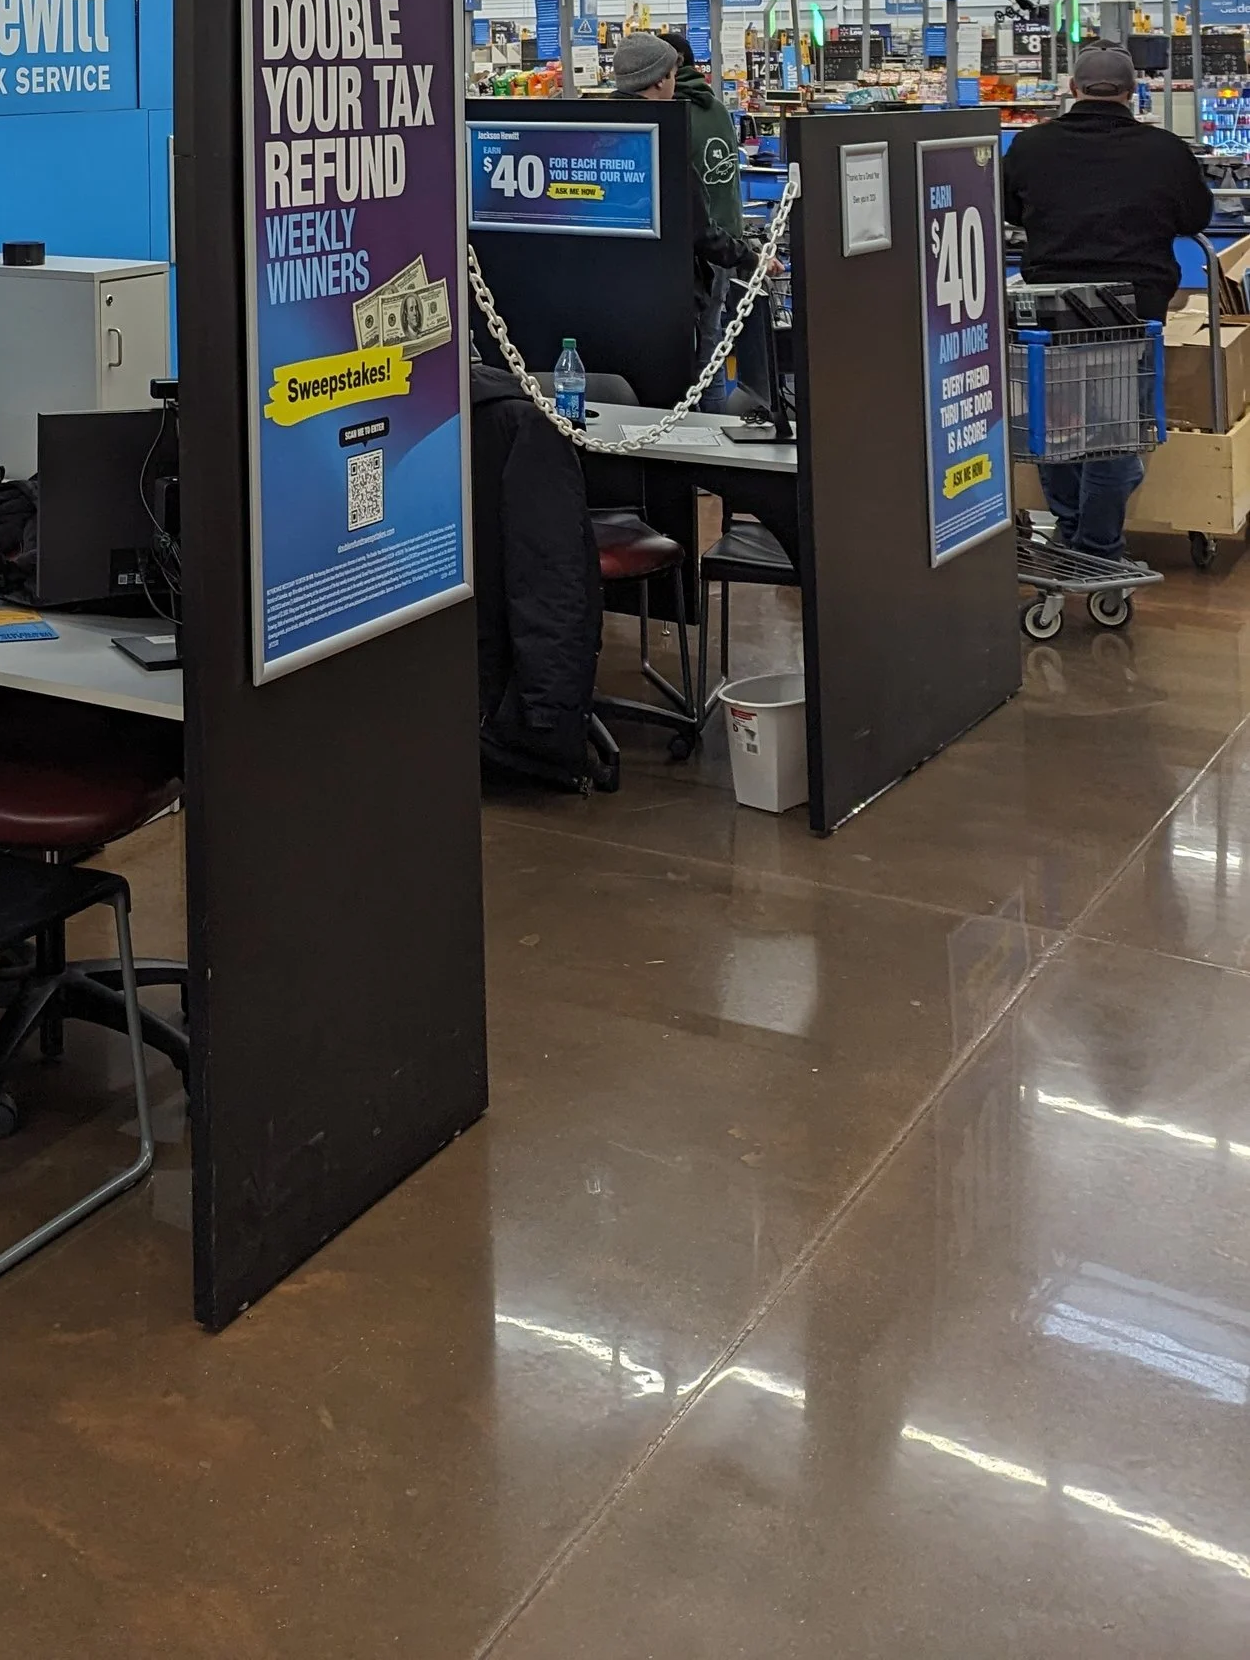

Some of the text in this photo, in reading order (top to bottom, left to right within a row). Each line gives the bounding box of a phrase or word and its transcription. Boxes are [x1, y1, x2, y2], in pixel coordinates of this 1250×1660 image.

[15, 64, 111, 95] SERVICE
[261, 64, 435, 135] YOUR TAX
[478, 132, 519, 140] Jackson Hewitt
[264, 134, 406, 210] REFUND
[483, 154, 545, 199] $40
[549, 158, 635, 170] FOR EACH FRIEND
[549, 170, 646, 183] YOU SEND OUR WAY
[555, 187, 568, 195] ASK
[582, 188, 596, 196] HOW
[929, 184, 952, 210] EARN
[265, 207, 356, 259] WEEKLY
[266, 249, 370, 305] WINNERS
[931, 206, 986, 324] $40
[939, 323, 989, 364] AND MORE
[287, 357, 391, 403] Sweepstakes!
[942, 365, 990, 400] EVERY FRIEND
[940, 390, 993, 429] THRU THE DOOR
[345, 429, 357, 441] SCAN
[948, 419, 988, 454] IS A SCORE!
[953, 461, 983, 487] ASK ME HOW
